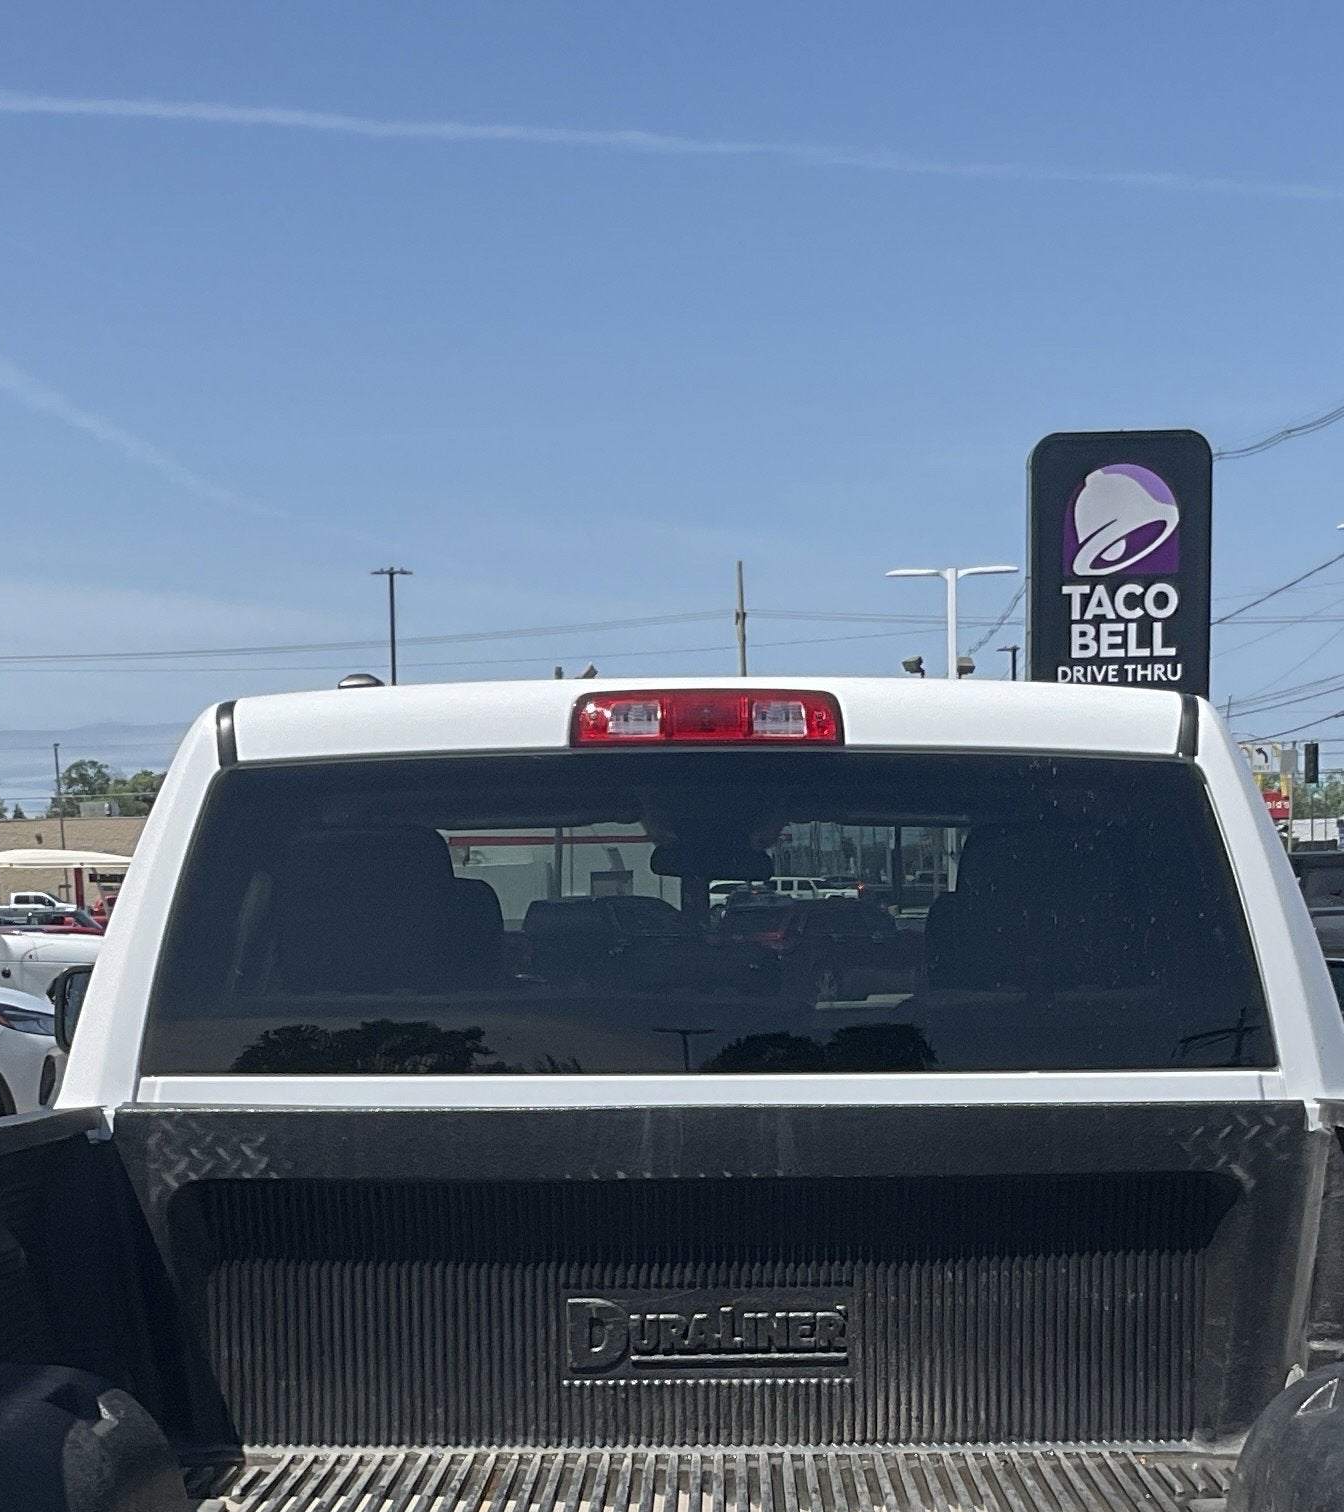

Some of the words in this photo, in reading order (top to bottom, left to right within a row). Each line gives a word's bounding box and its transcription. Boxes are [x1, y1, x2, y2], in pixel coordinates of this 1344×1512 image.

[1061, 583, 1179, 620] TACO
[1070, 622, 1177, 659] BELL
[1057, 665, 1119, 684] DRIVE
[1124, 663, 1182, 682] THRU
